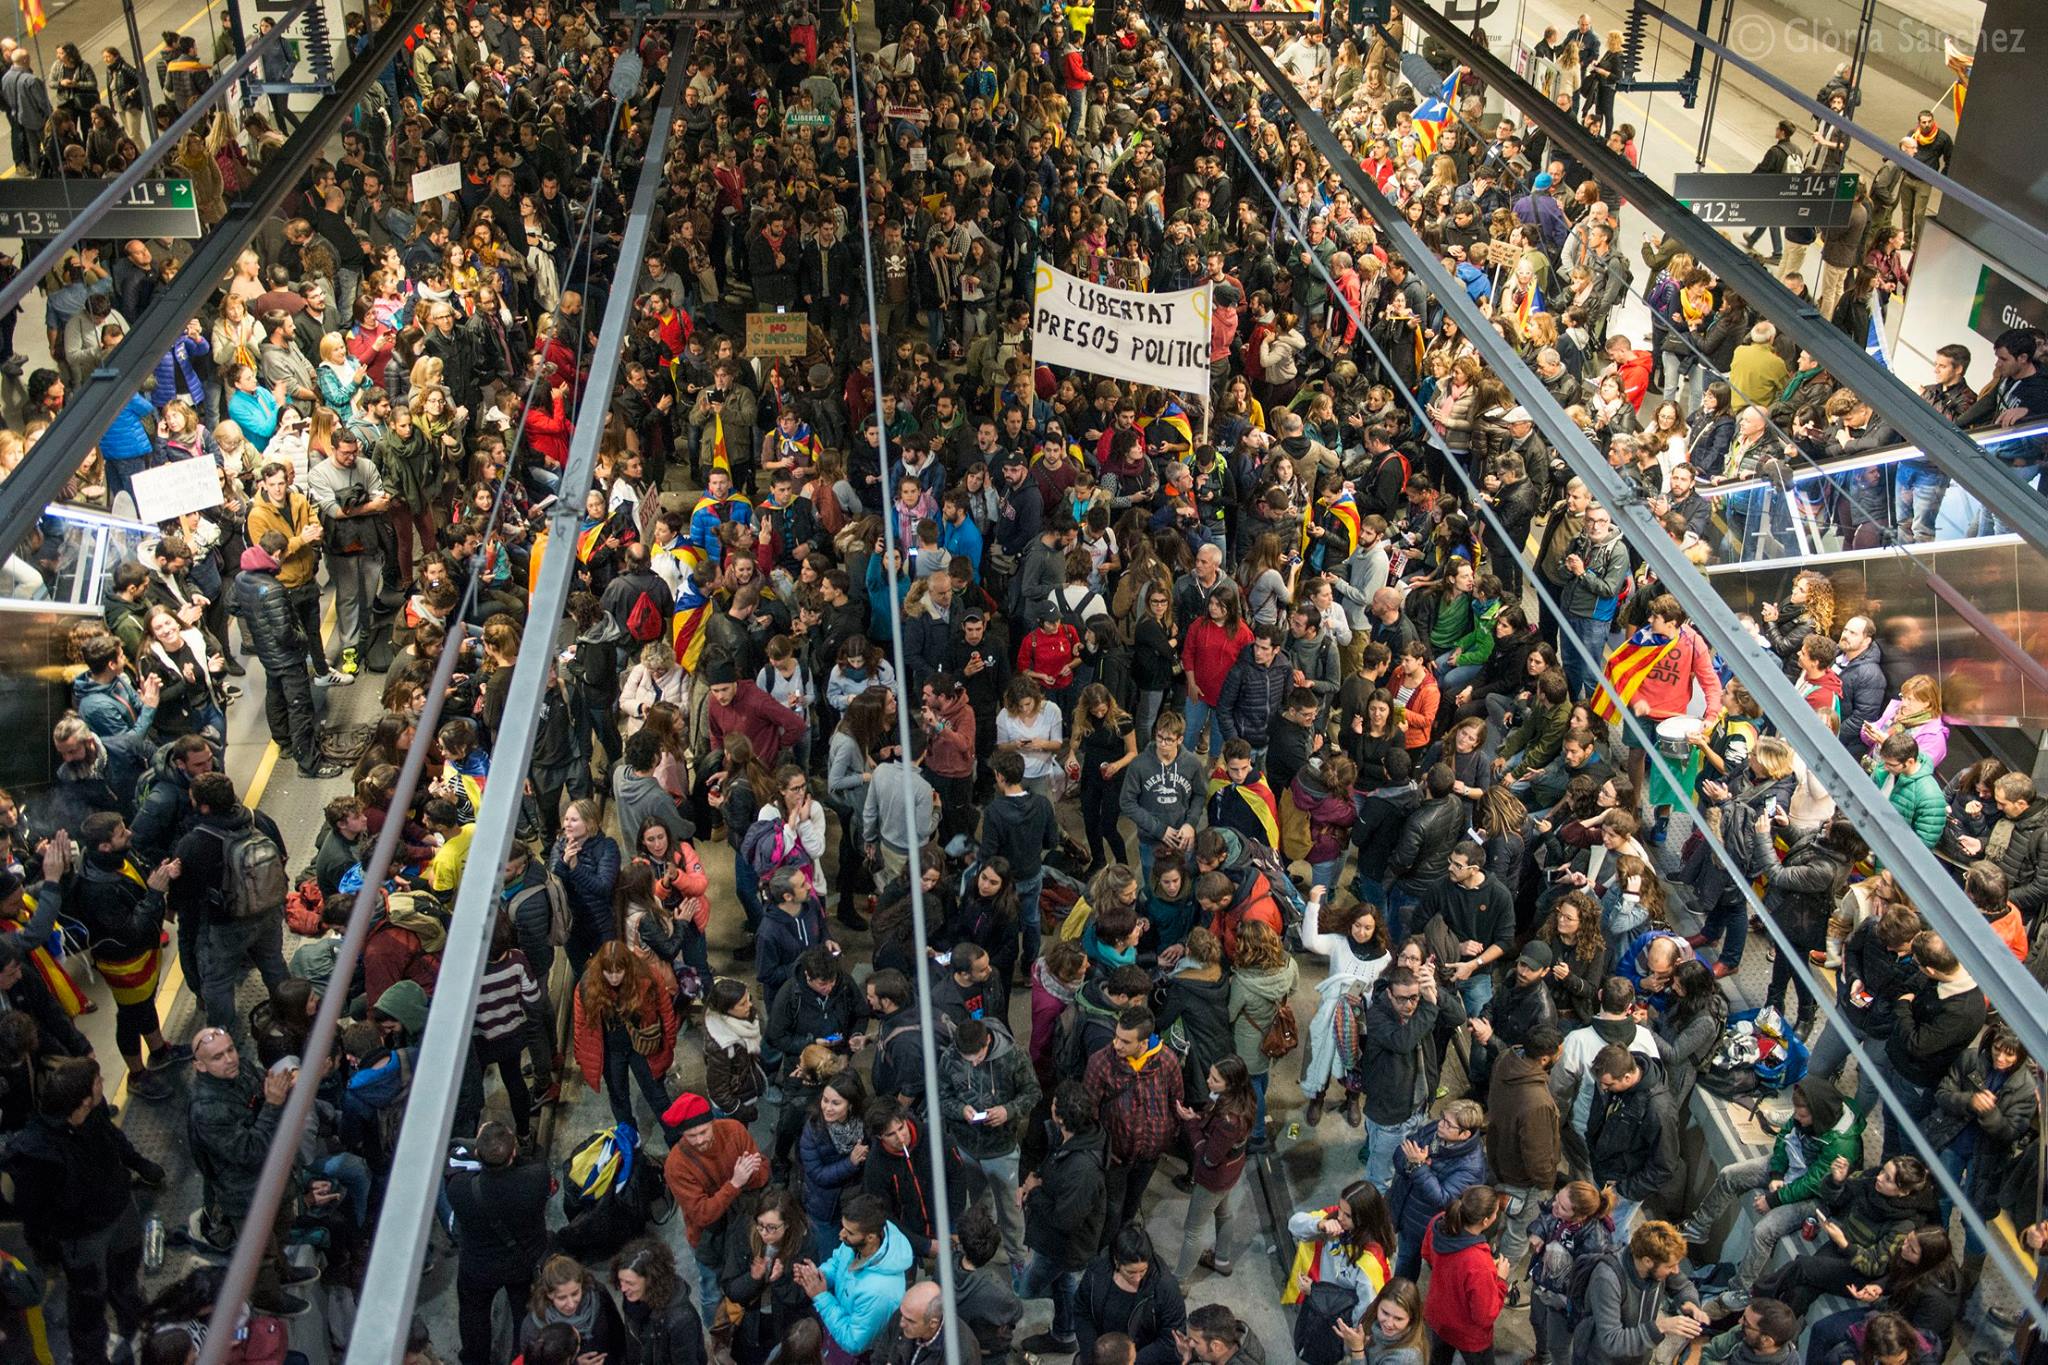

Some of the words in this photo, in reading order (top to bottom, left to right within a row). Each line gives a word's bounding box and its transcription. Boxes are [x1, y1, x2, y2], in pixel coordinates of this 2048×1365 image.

[791, 114, 826, 122] LLIBERTAT
[128, 182, 155, 205] 11
[1802, 176, 1826, 196] 14
[13, 211, 44, 235] 13
[1702, 202, 1727, 222] 12
[1067, 281, 1176, 325] LLIBERTAT
[769, 323, 788, 333] NO
[2002, 304, 2037, 330] Giro
[1036, 308, 1120, 355] PRESOS
